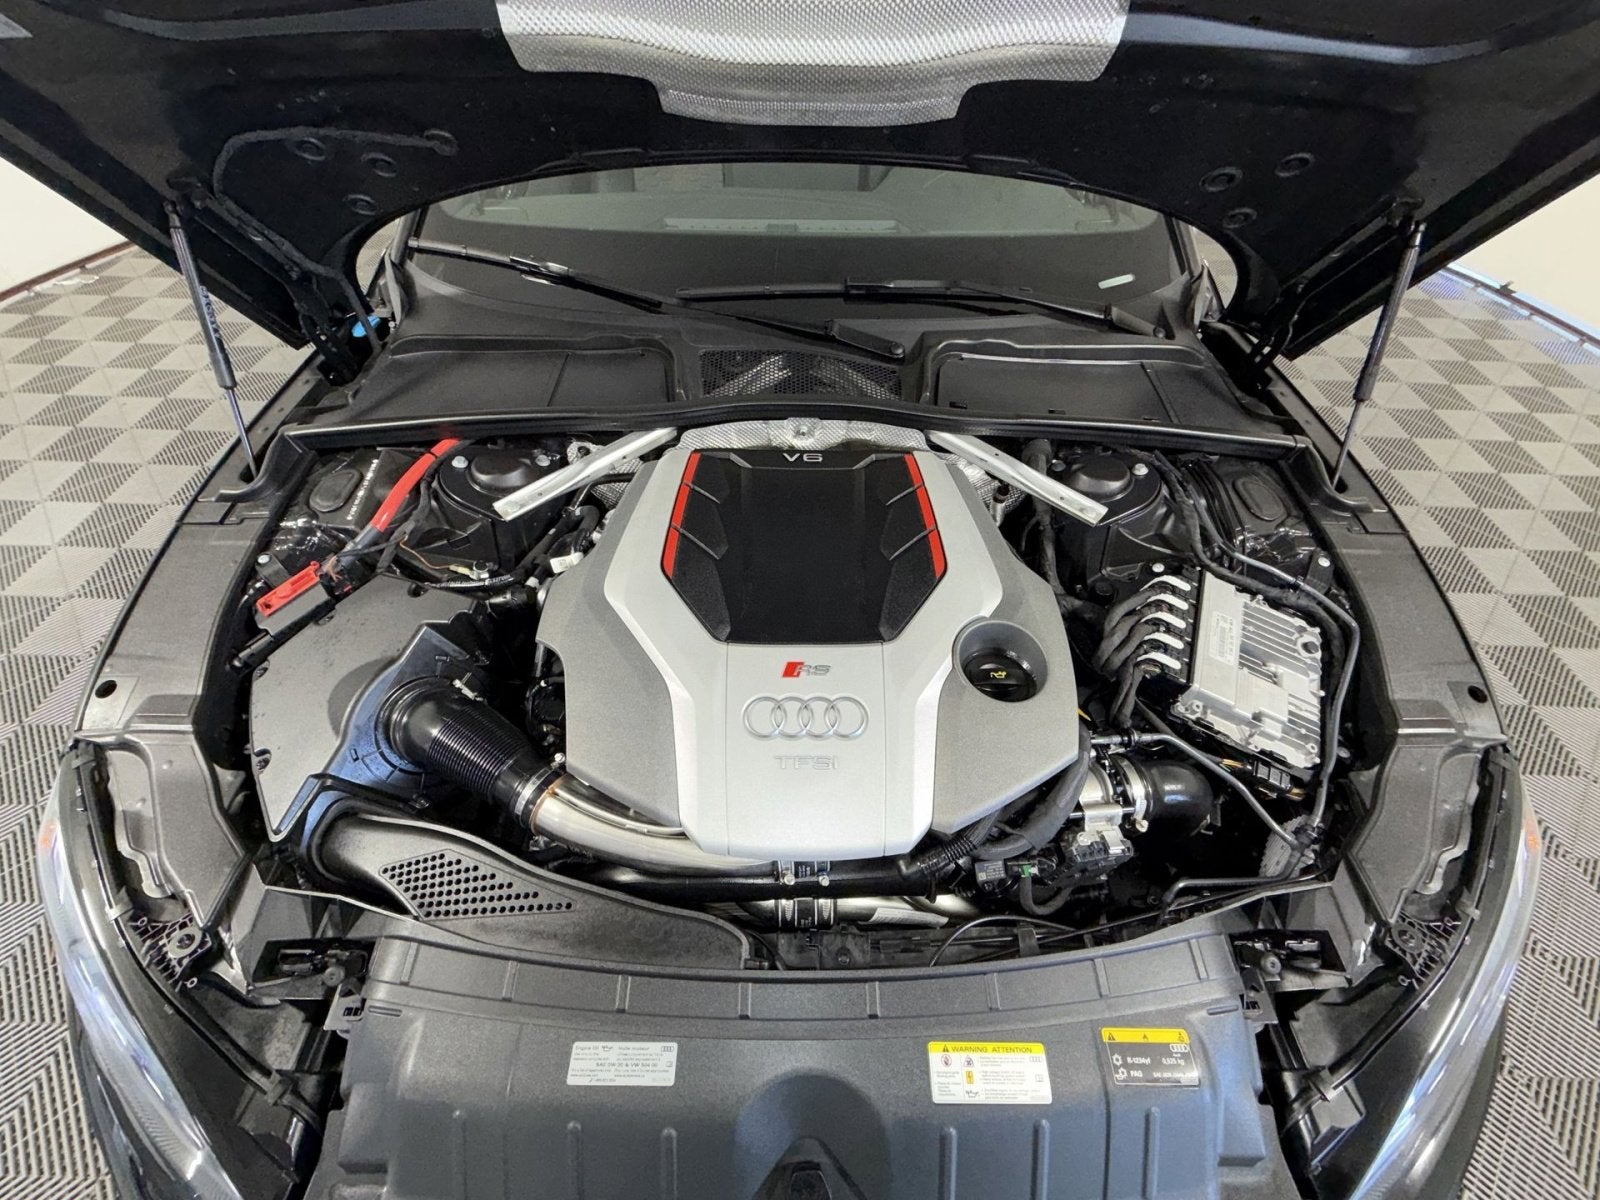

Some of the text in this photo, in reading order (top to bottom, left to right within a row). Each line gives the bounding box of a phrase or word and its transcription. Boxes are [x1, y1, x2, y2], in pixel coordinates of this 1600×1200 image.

[782, 452, 823, 462] V6
[784, 661, 831, 678] RS
[774, 755, 837, 770] TFSI
